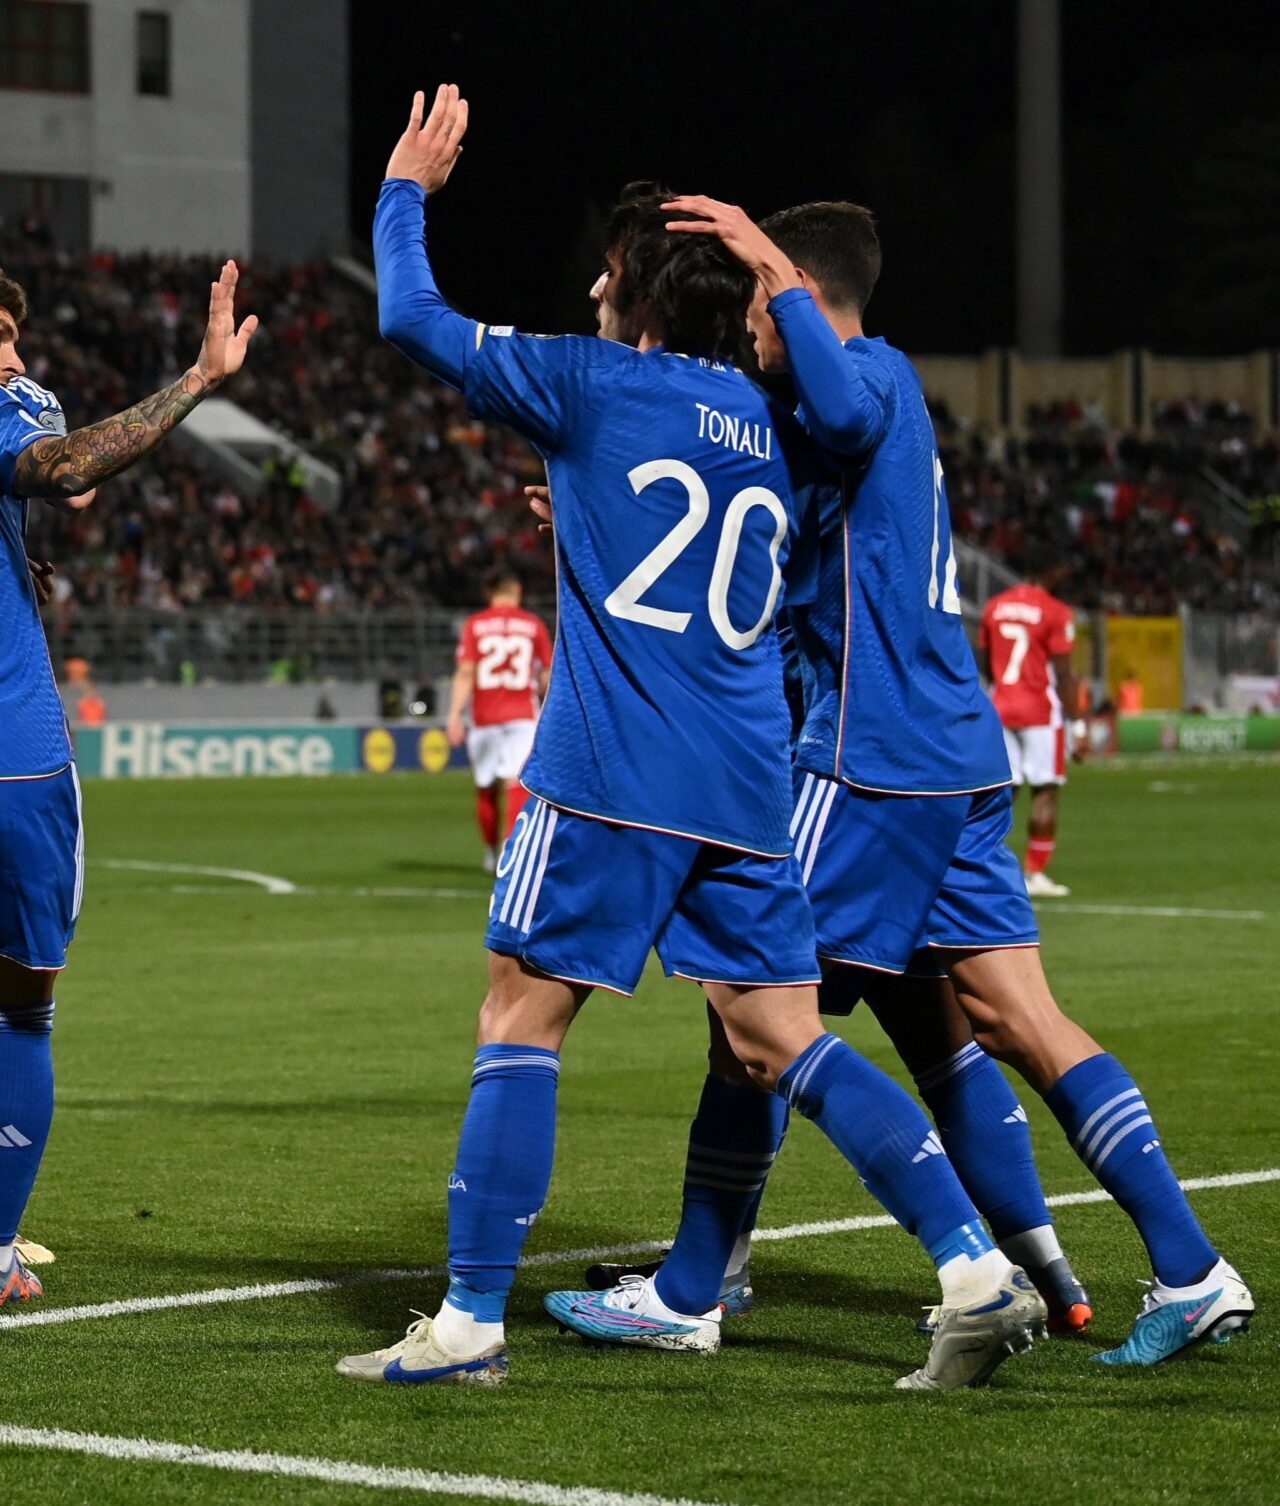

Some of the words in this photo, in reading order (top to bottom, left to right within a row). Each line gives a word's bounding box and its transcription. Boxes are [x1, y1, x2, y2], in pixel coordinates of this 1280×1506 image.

[695, 403, 770, 460] TONALI
[604, 458, 788, 650] 20
[477, 635, 533, 691] 23
[999, 622, 1029, 685] 7
[100, 721, 333, 777] Hisense
[496, 811, 528, 878] 0
